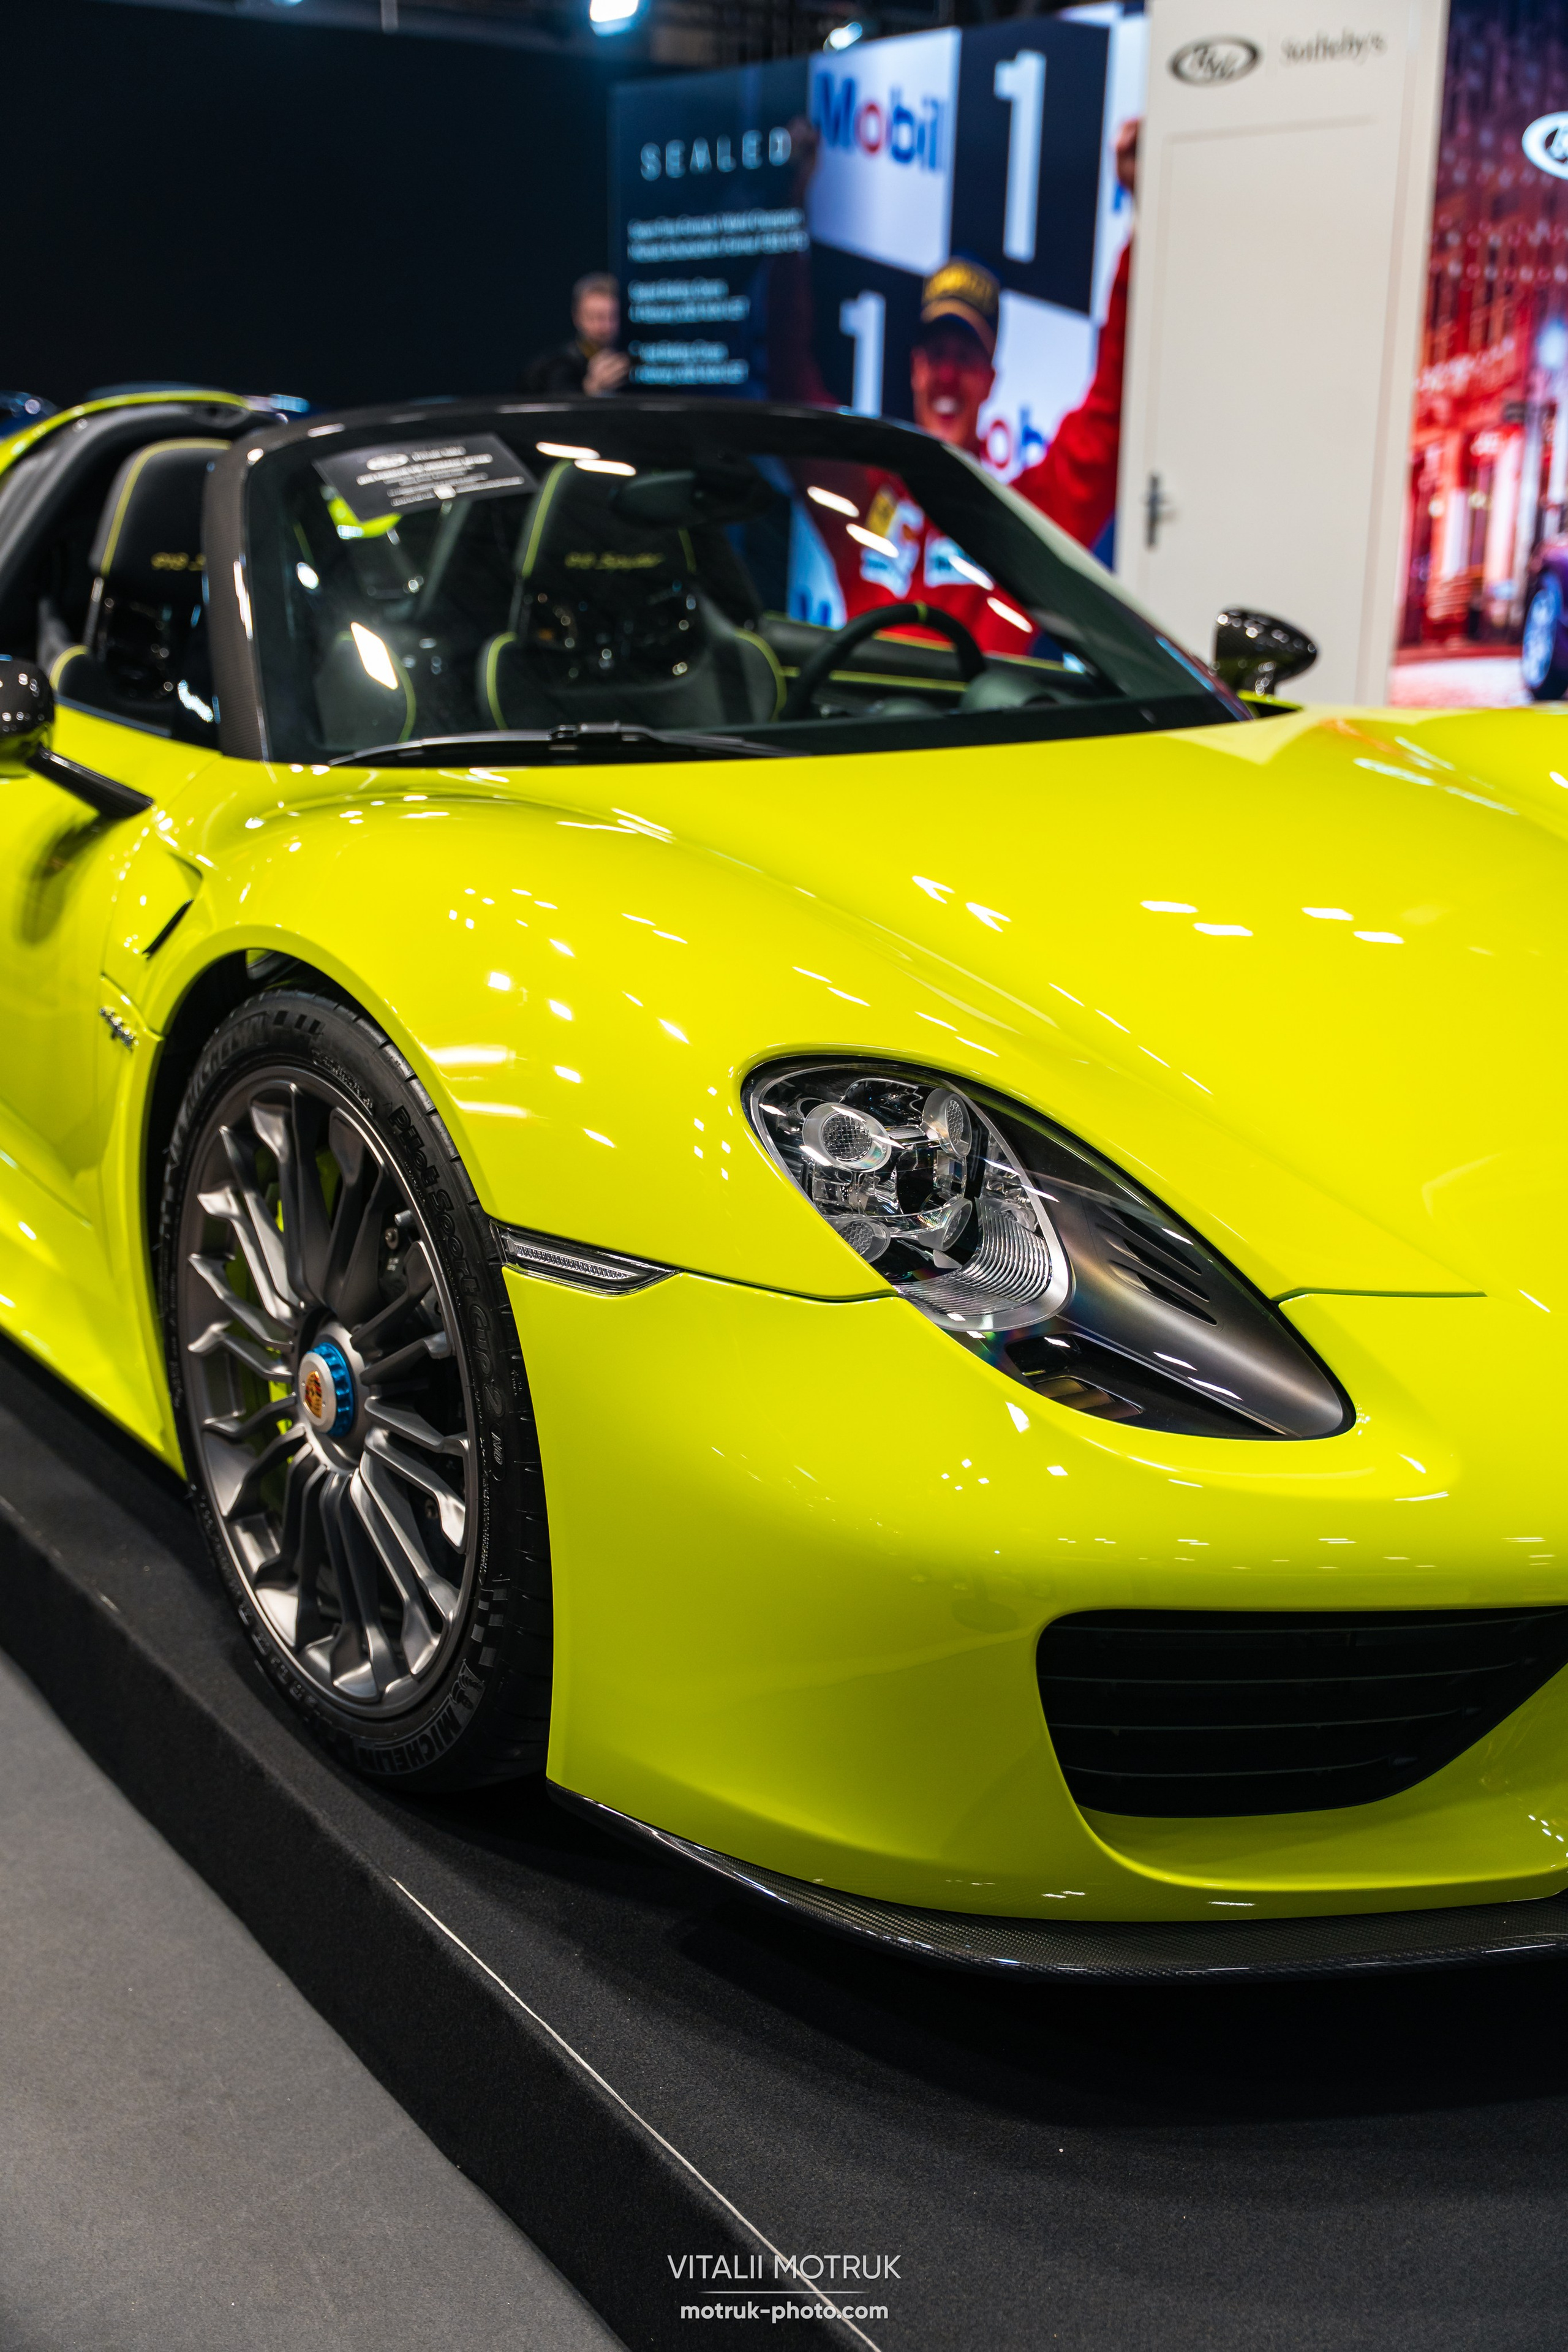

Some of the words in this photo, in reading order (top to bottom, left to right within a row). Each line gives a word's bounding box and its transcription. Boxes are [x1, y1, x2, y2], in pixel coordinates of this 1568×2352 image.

[641, 127, 791, 181] SEALED
[813, 70, 947, 176] Mobil
[993, 49, 1046, 265] 1
[839, 290, 886, 418] 1
[388, 1105, 440, 1188] Pilot
[429, 1189, 480, 1297] Sport
[469, 1303, 492, 1376] Cup
[357, 1704, 462, 1772] MICHELIN
